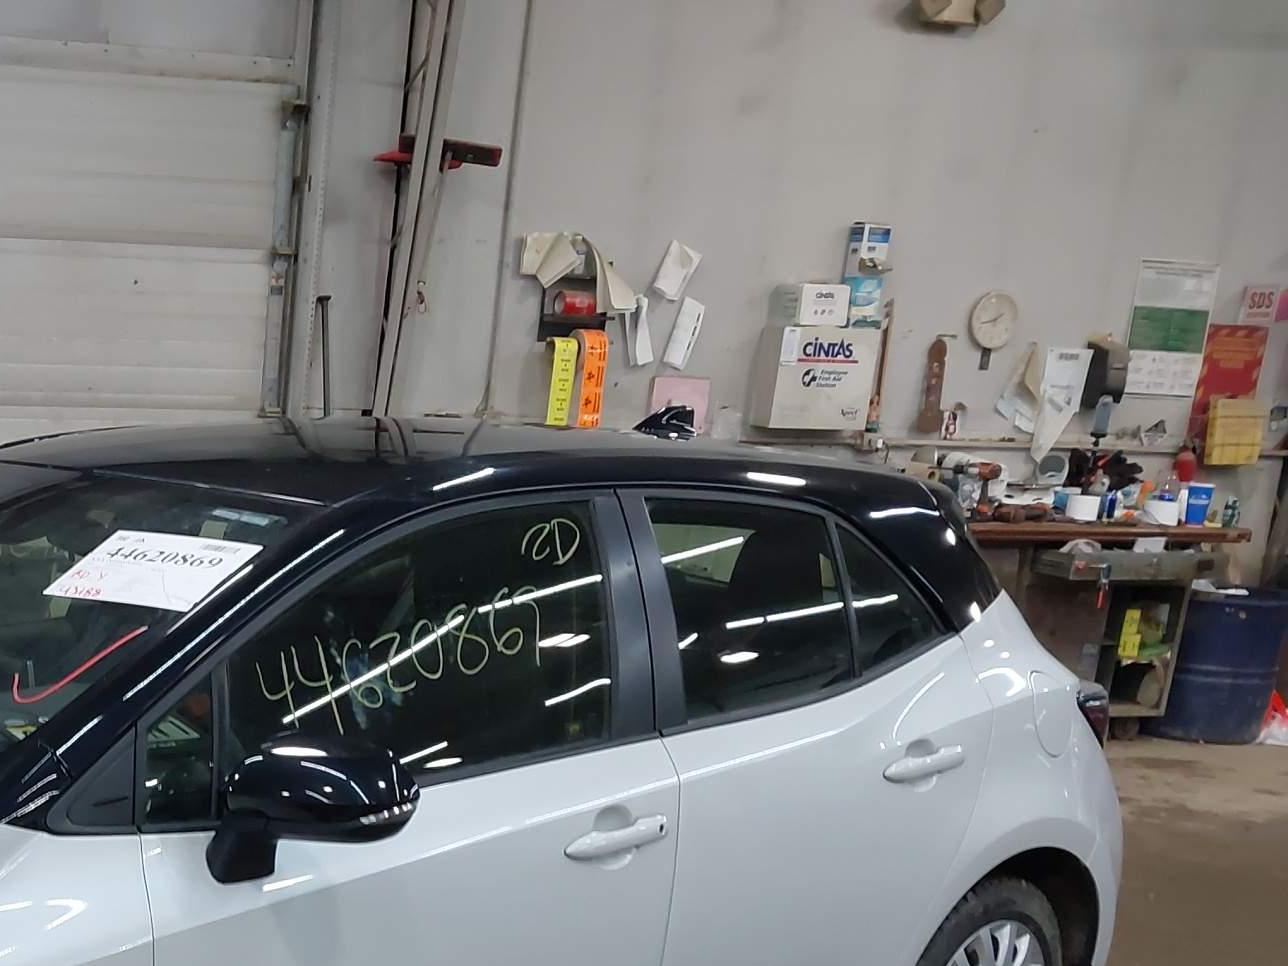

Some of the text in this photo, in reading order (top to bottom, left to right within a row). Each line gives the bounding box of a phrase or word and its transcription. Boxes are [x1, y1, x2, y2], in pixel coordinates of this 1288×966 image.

[1248, 292, 1275, 310] SDS
[106, 546, 224, 569] 44620869
[255, 585, 541, 737] 44620869
